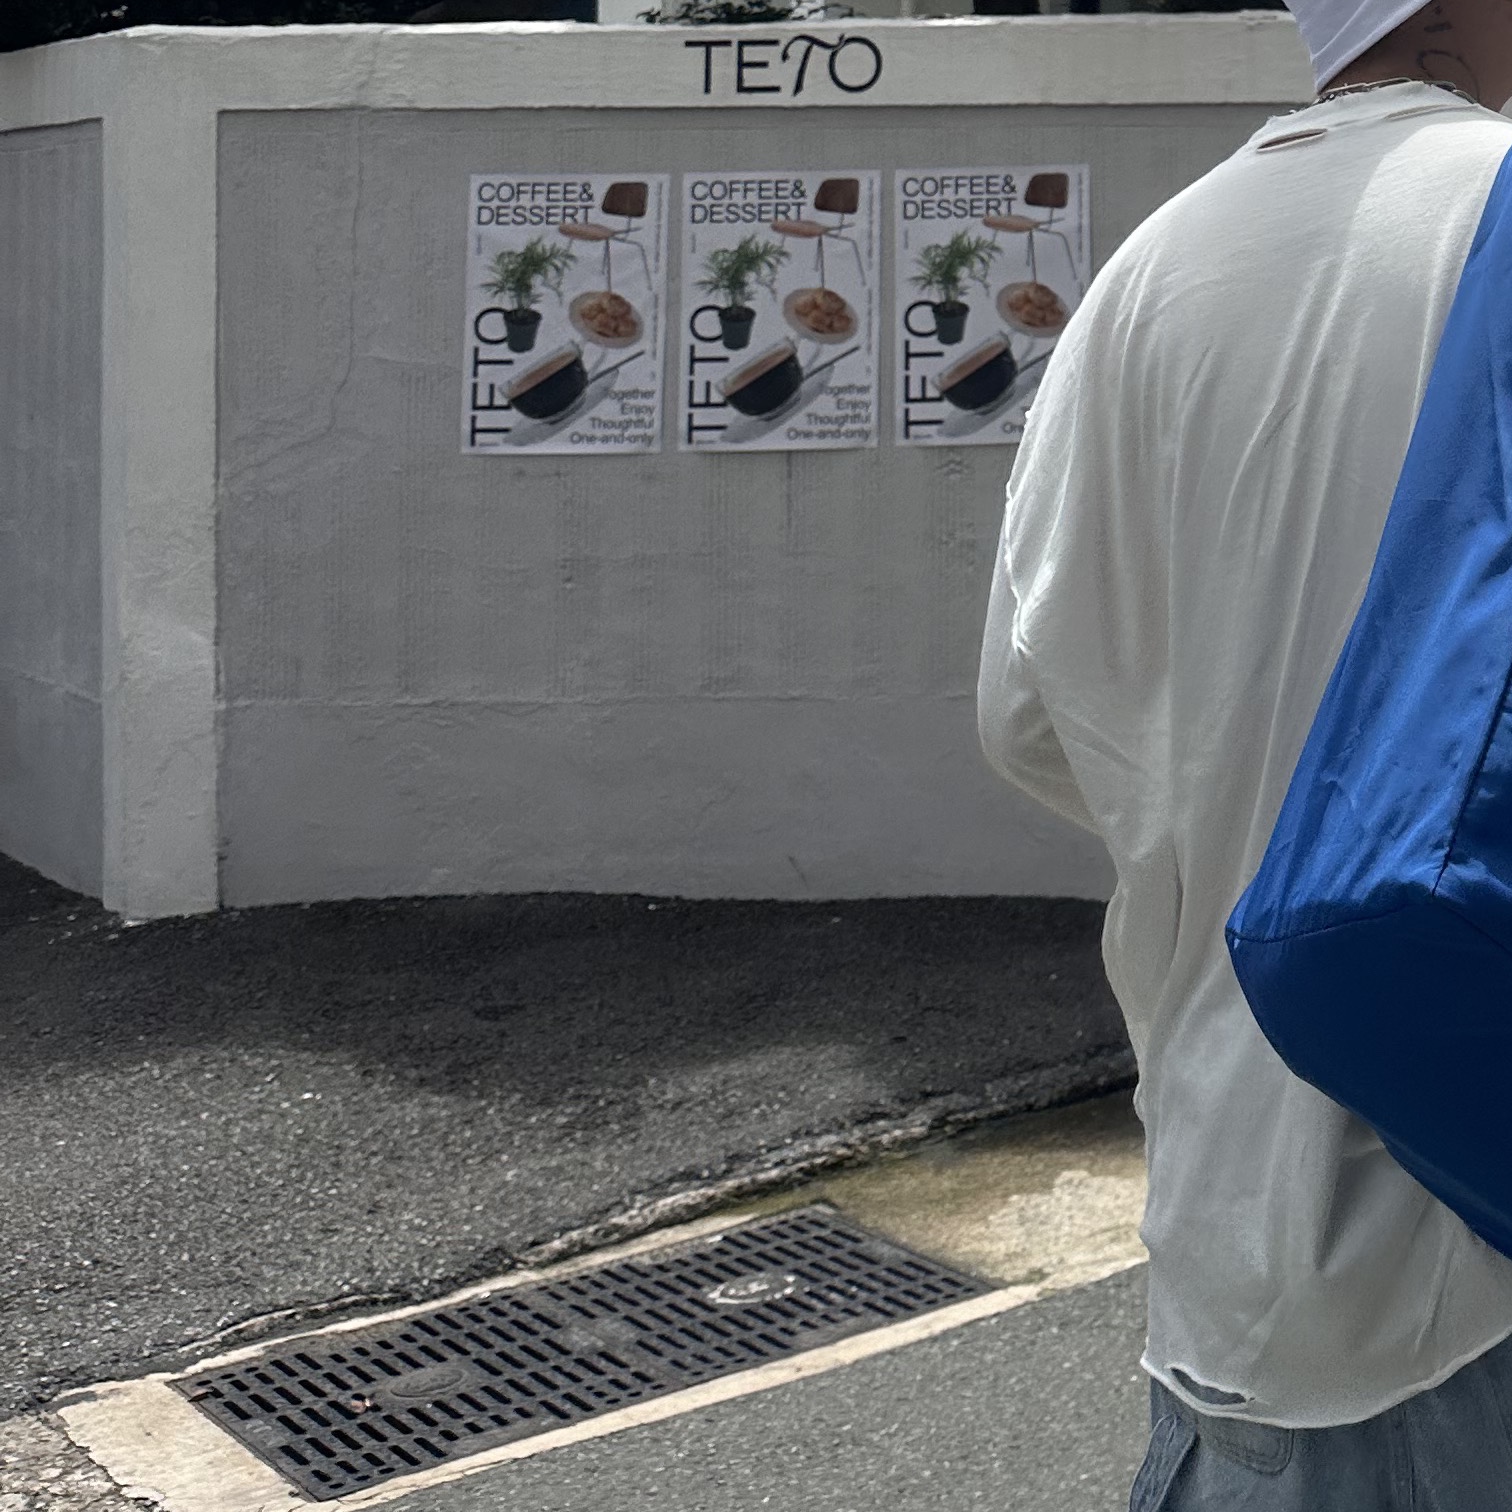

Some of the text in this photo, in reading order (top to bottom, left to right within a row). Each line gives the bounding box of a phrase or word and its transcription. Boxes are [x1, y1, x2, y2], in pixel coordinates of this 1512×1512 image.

[684, 33, 883, 97] TETO
[477, 181, 595, 203] COFFEE&
[690, 179, 807, 202] COFFEE&
[902, 173, 1017, 198] COFFEE&
[476, 204, 596, 226] DESSERT
[690, 202, 807, 224] DESSERT
[902, 197, 1018, 220] DESSERT
[470, 306, 515, 447] TETO
[687, 304, 730, 445] TETO
[904, 299, 945, 440] TETO
